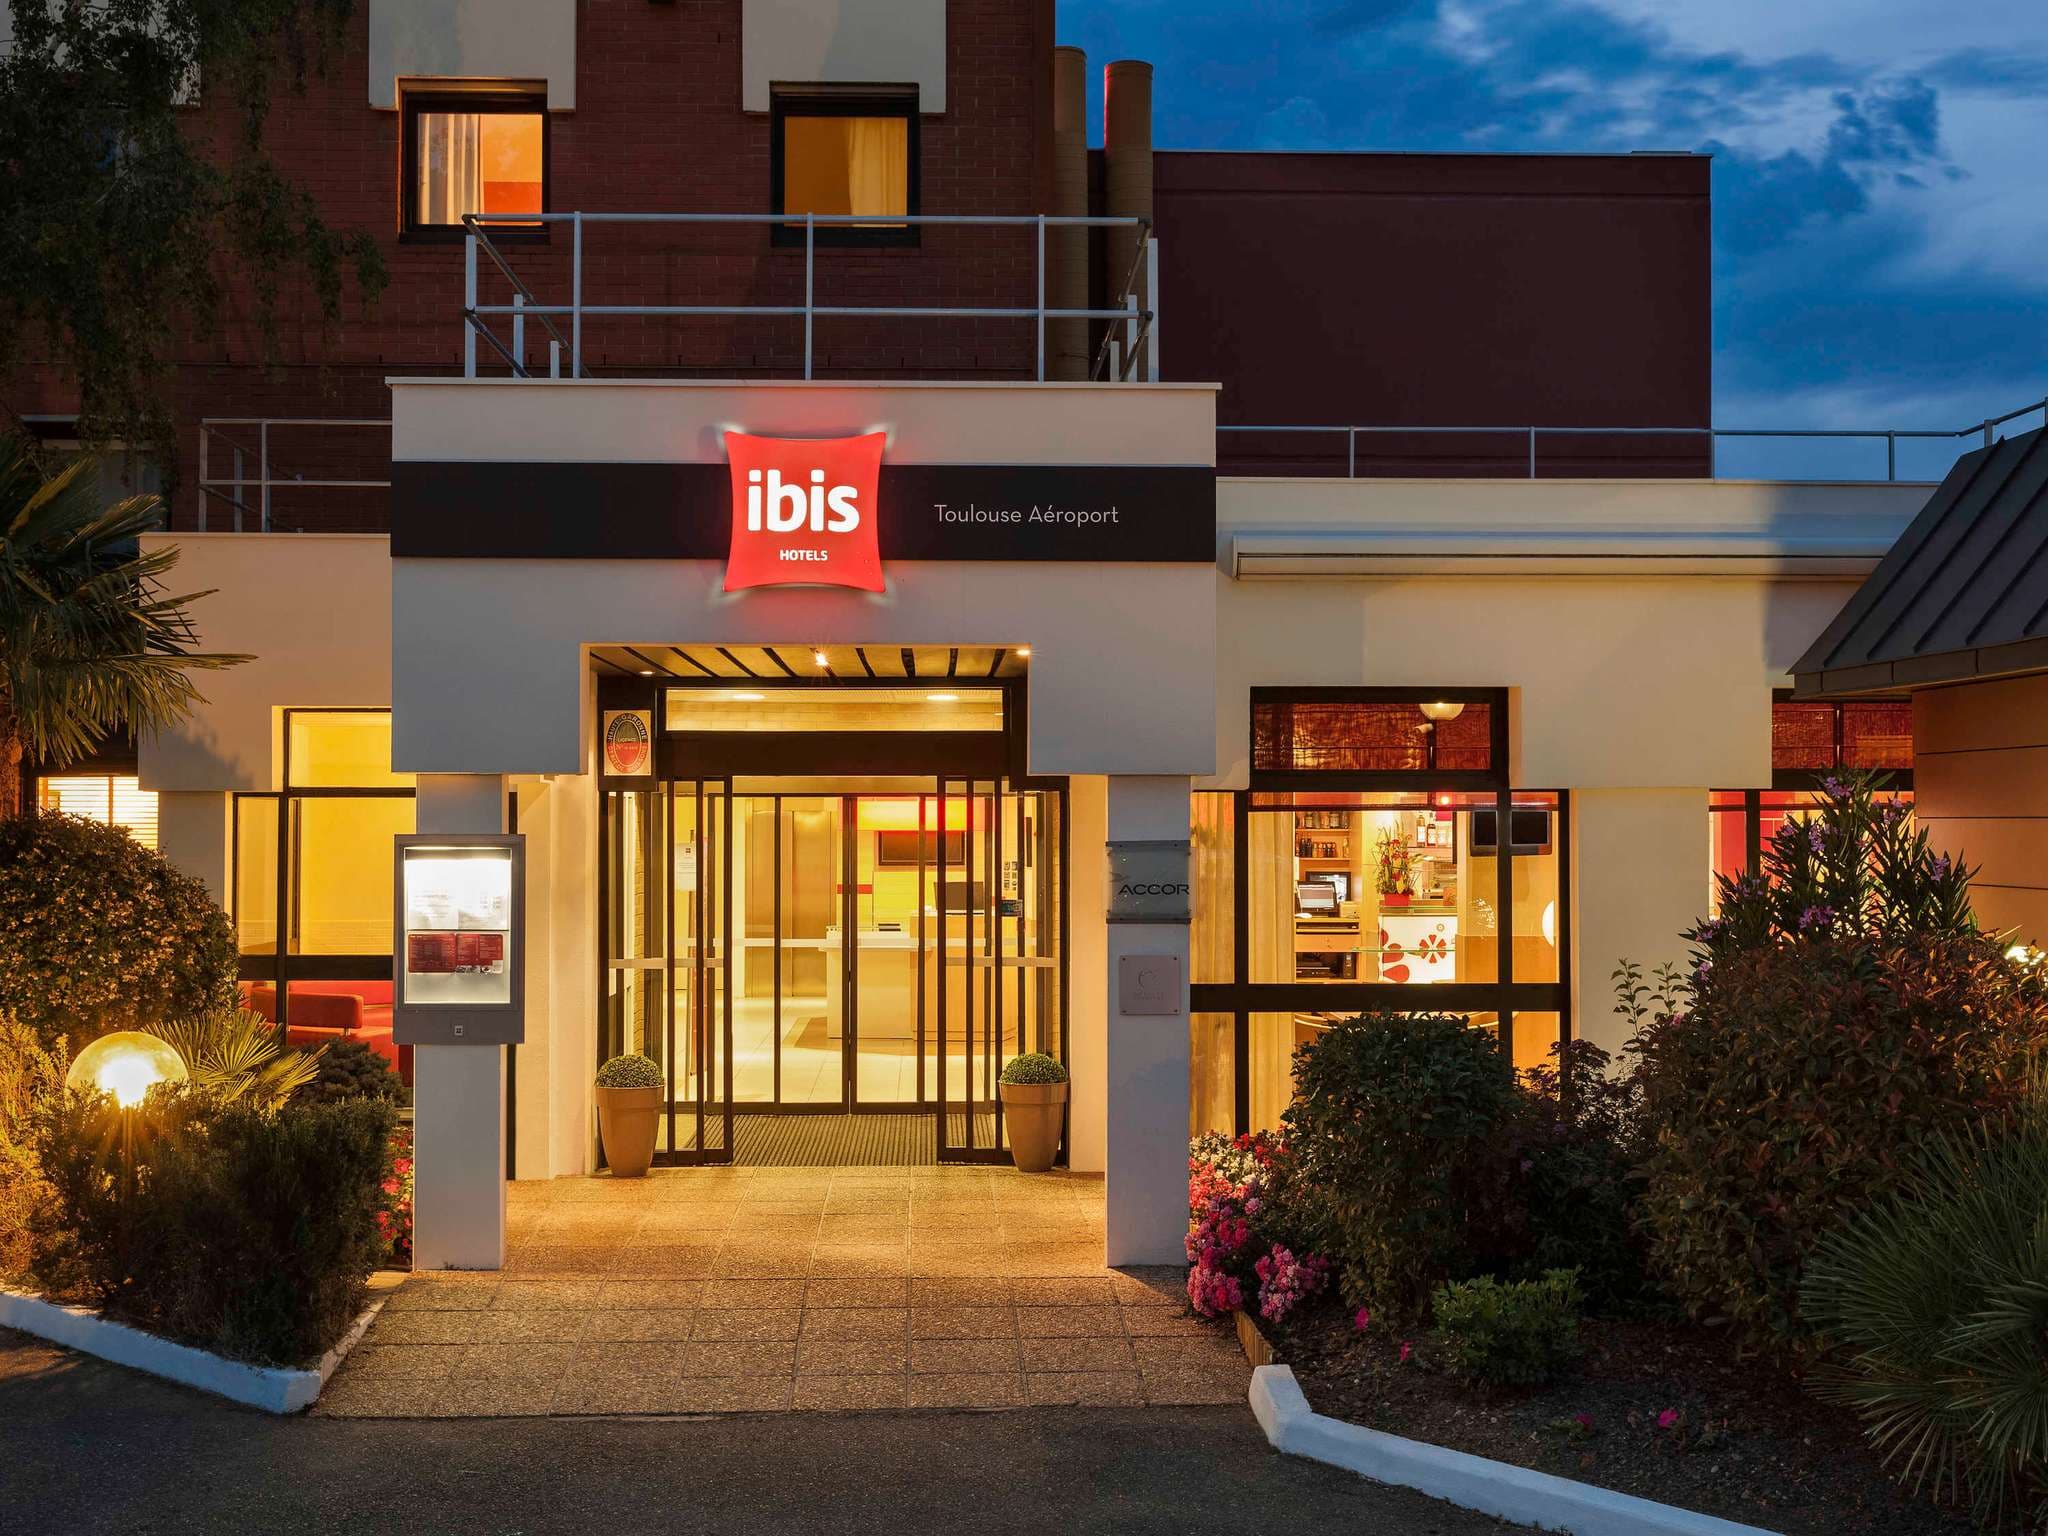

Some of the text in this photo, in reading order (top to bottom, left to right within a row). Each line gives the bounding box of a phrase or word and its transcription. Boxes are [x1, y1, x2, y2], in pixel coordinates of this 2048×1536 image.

[747, 468, 860, 533] ibis
[933, 503, 1120, 528] Toulouse Aéroport
[779, 549, 828, 561] HOTELS
[1118, 883, 1190, 896] ACCOR
